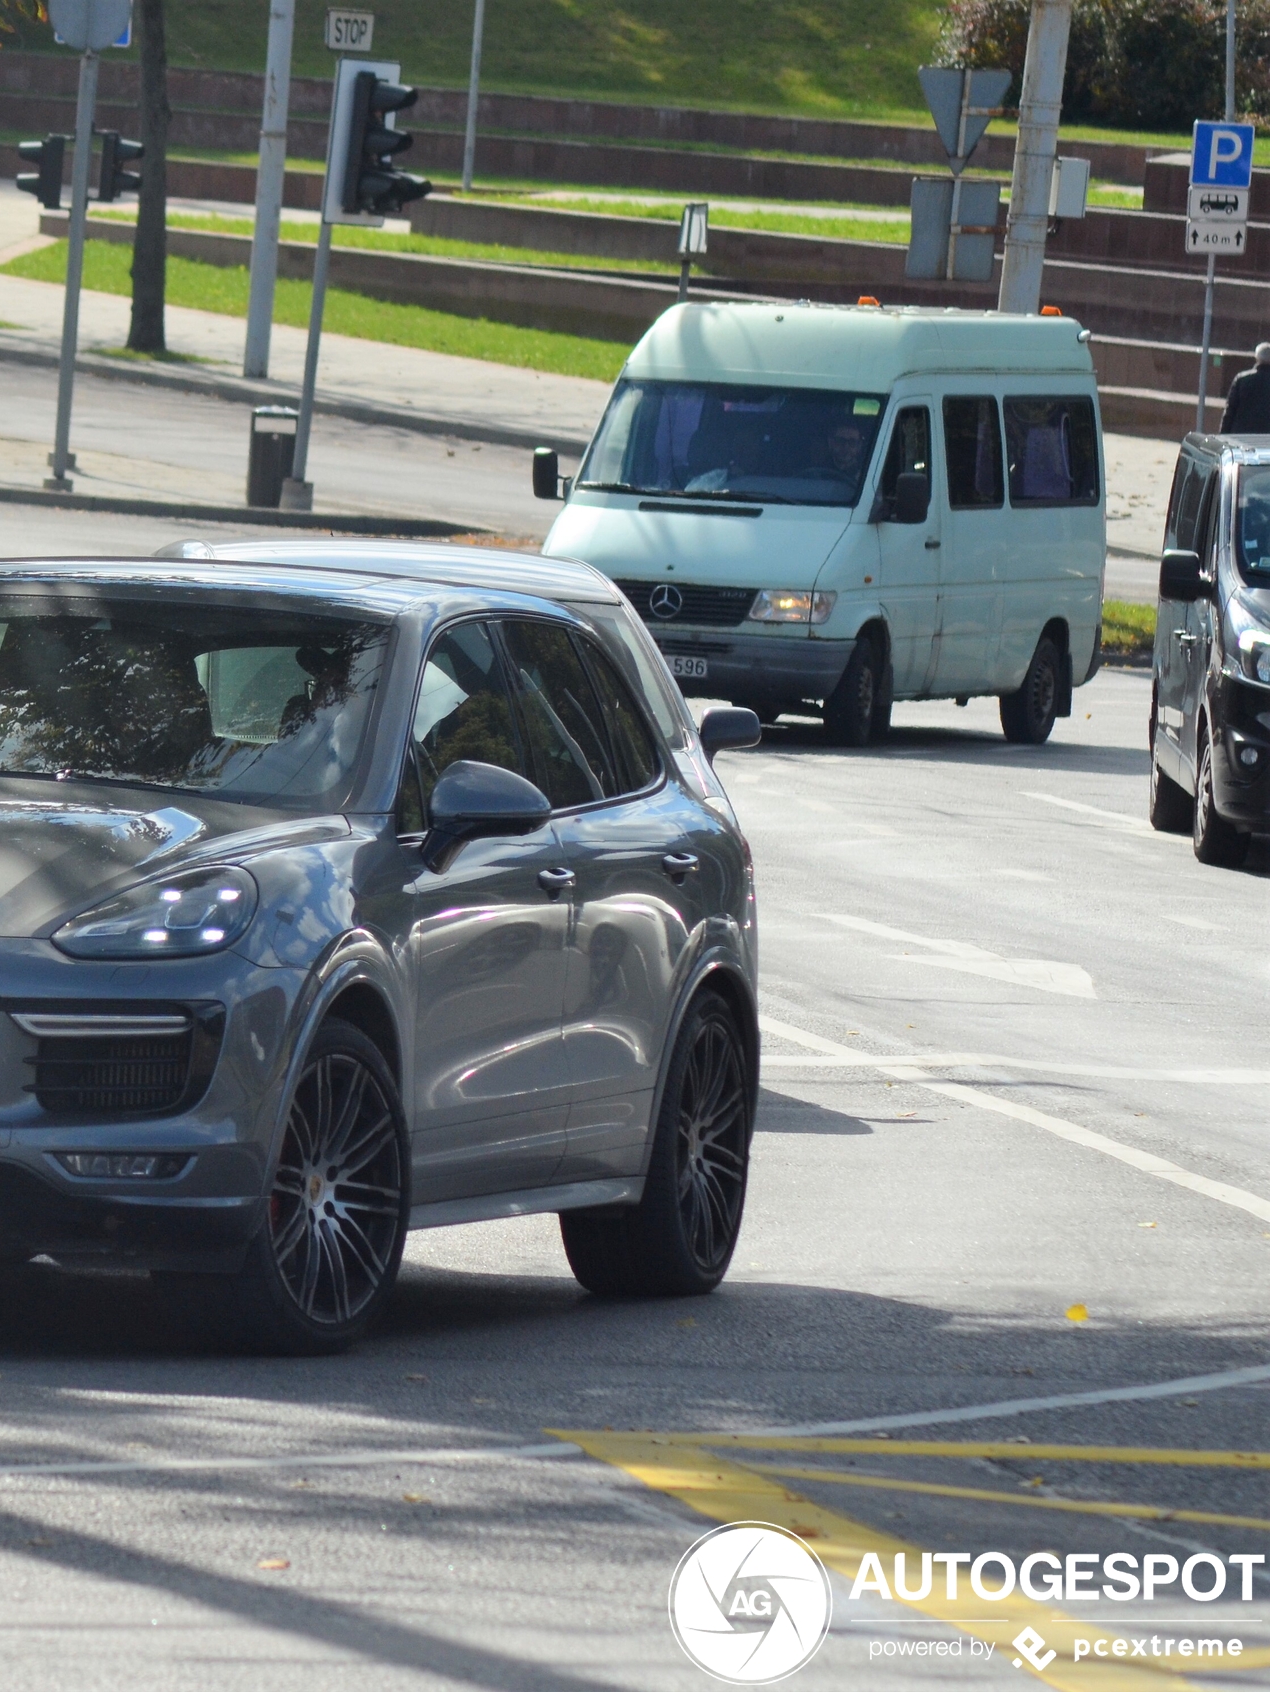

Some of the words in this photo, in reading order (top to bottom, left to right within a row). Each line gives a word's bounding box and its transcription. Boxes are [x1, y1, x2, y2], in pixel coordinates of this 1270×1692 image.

[335, 17, 367, 44] STOP
[1208, 130, 1243, 180] P
[1203, 233, 1219, 245] 40
[1221, 235, 1231, 245] m
[673, 658, 705, 676] 596
